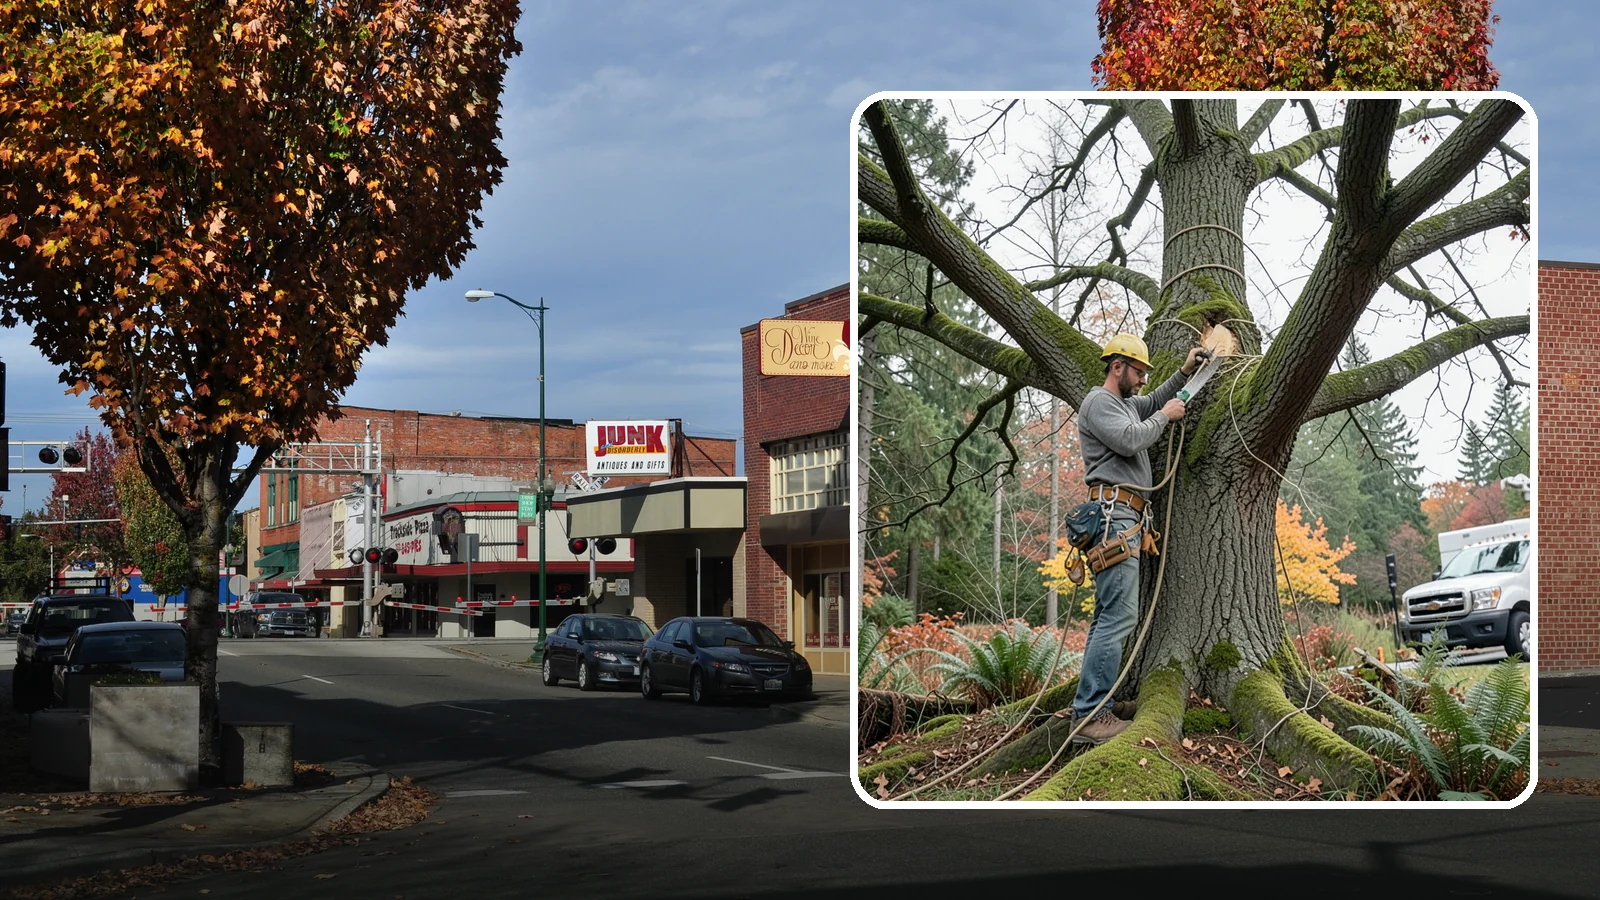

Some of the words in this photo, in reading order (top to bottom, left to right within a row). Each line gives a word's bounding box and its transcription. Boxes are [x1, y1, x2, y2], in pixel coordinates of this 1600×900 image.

[595, 425, 664, 457] JUNK
[607, 445, 646, 454] DISORDERLY
[597, 461, 628, 470] ANTIQUES
[631, 461, 644, 470] AND
[647, 460, 665, 470] GIFTS
[390, 521, 413, 540] Trackside
[415, 519, 429, 535] Pizza
